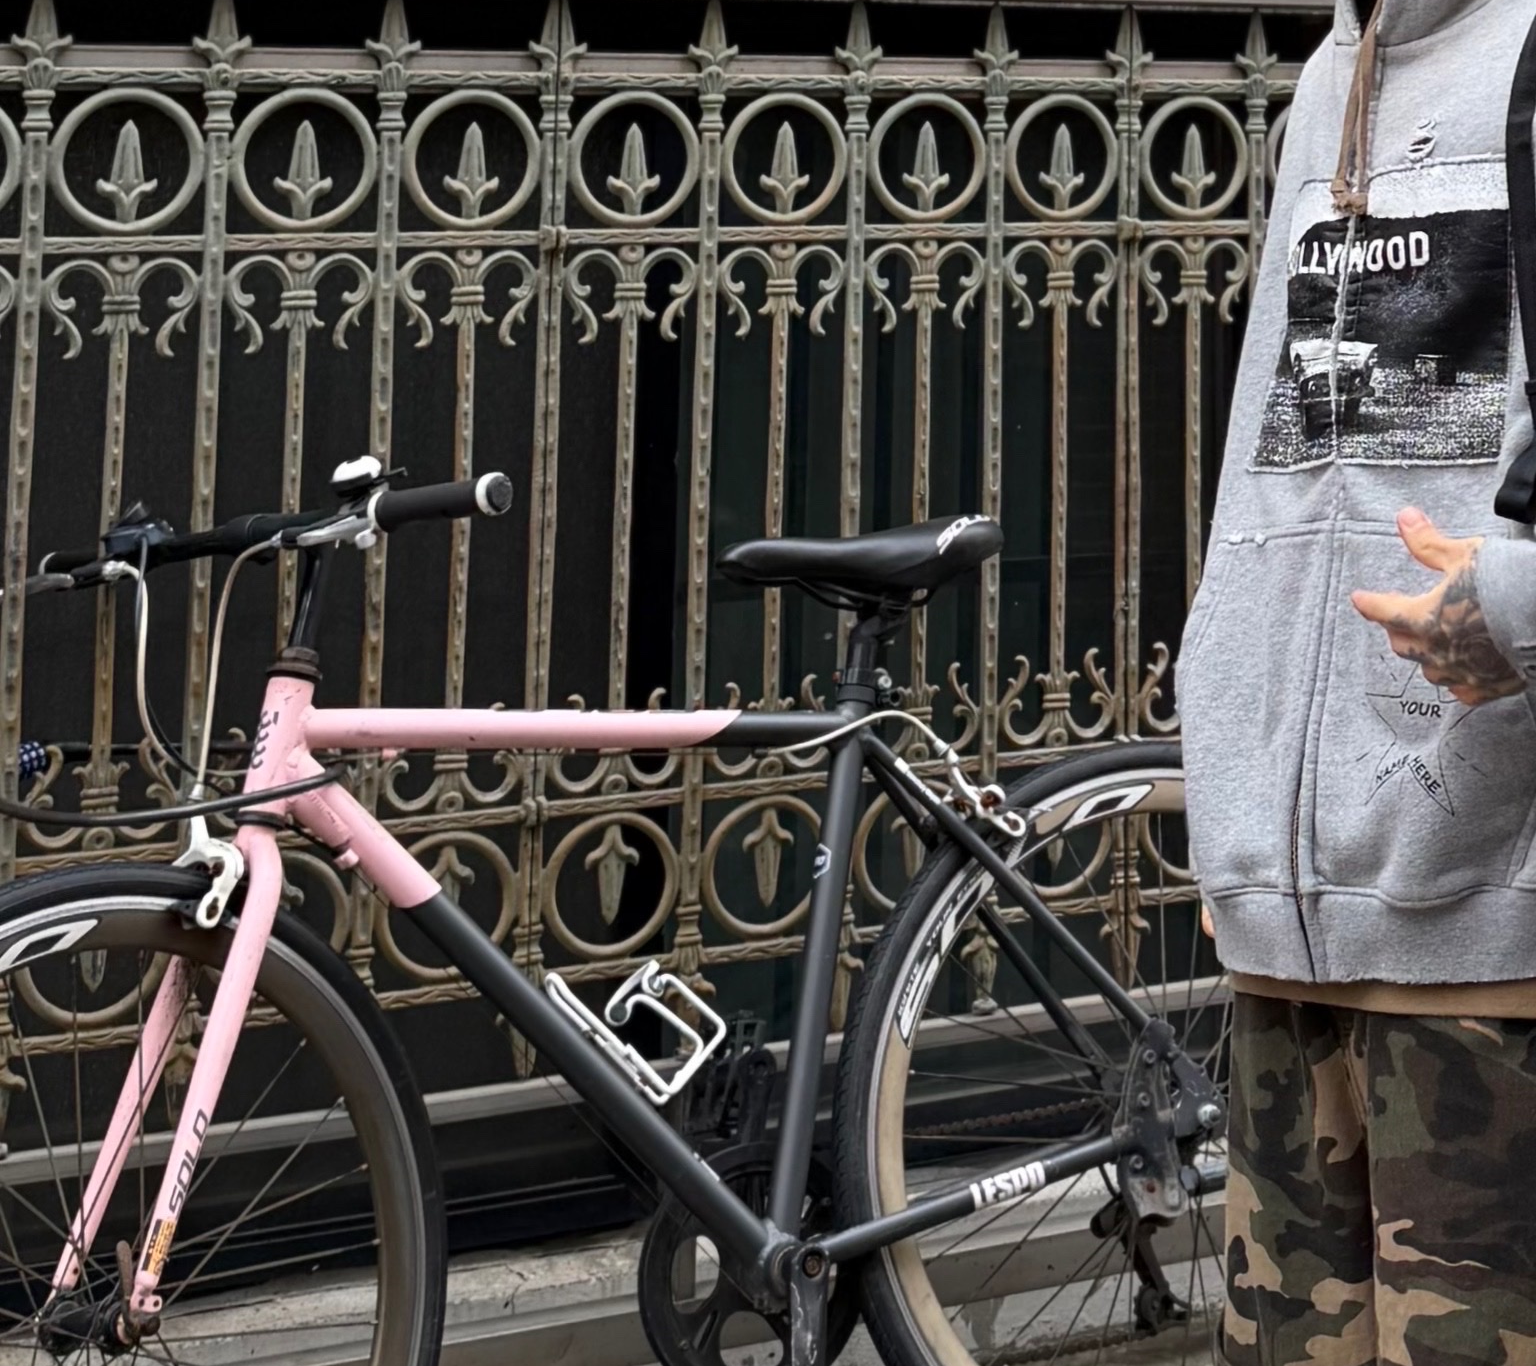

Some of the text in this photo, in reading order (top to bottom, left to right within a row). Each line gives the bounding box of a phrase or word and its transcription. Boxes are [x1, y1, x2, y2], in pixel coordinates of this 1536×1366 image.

[1399, 700, 1442, 718] YOUR
[1407, 755, 1442, 795] HERE
[168, 1108, 210, 1216] SOLO
